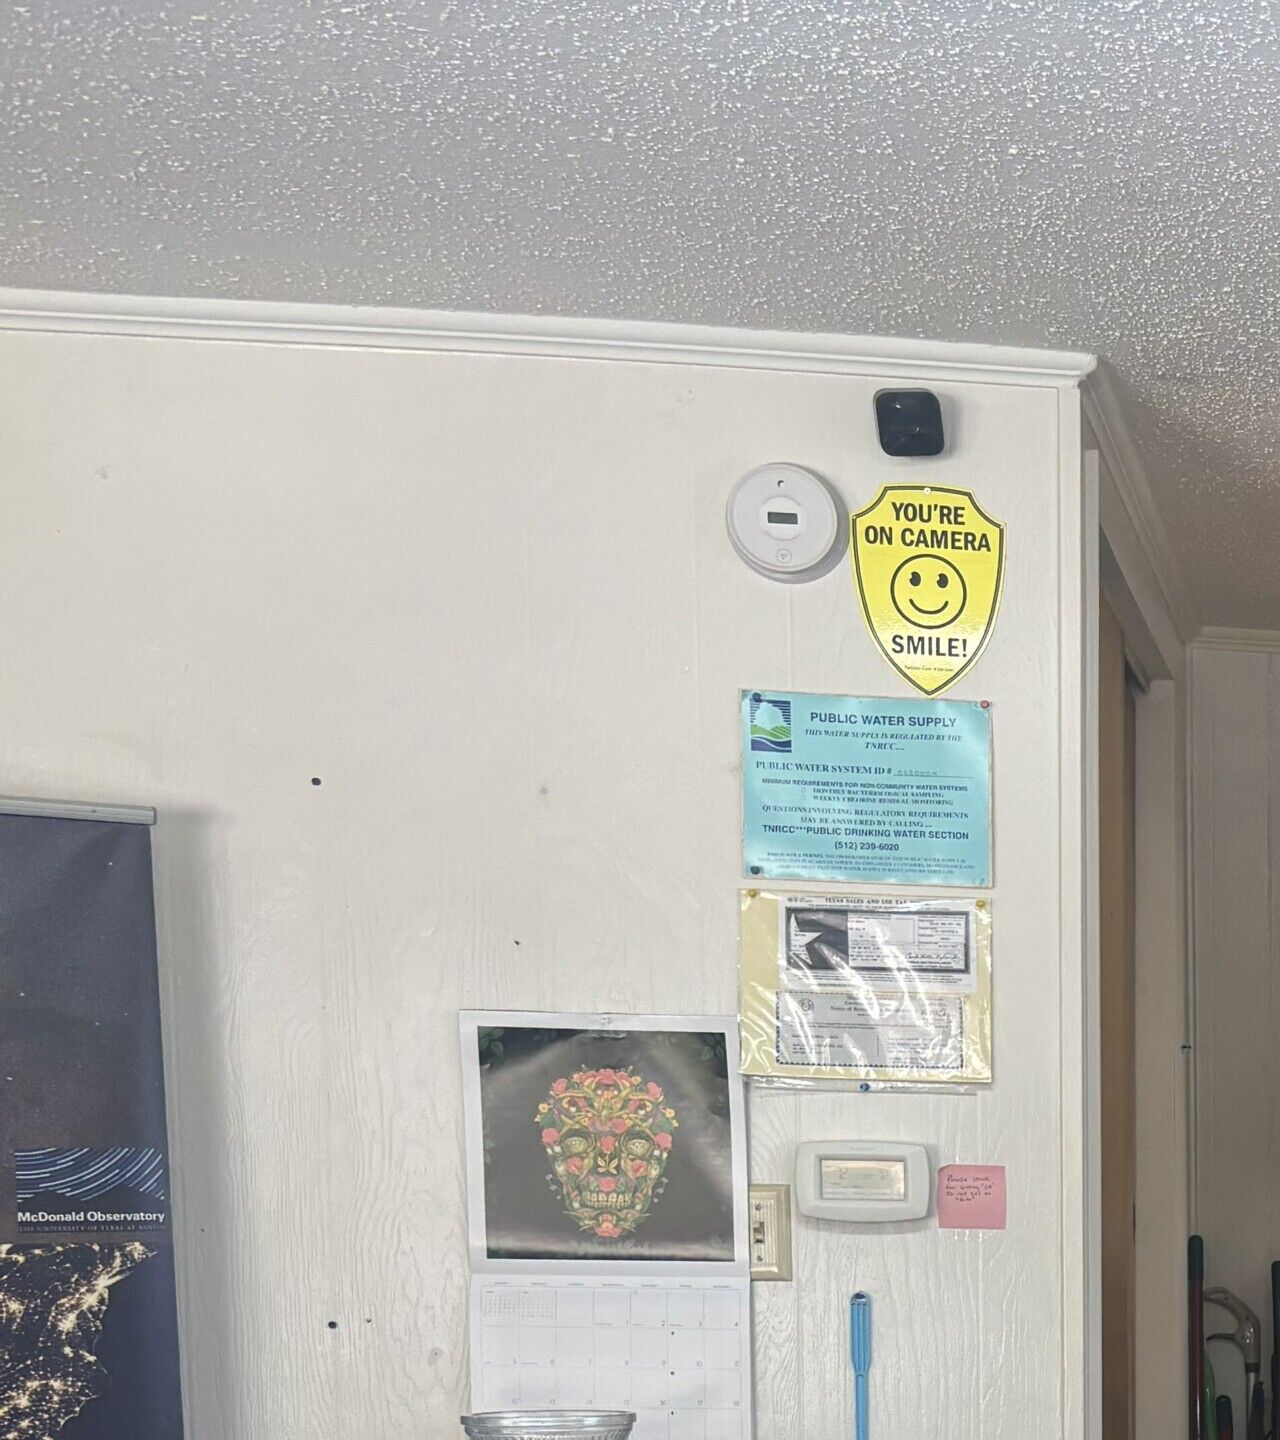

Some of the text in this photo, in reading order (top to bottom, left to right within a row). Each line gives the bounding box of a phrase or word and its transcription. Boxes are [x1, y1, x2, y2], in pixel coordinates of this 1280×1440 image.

[891, 502, 965, 525] YOU'RE
[865, 525, 991, 552] ON CAMERA
[891, 635, 968, 657] SMILE!
[811, 712, 956, 728] PUBLIC WATER SUPPLY
[844, 828, 969, 840] DRINKING WATER SECTION
[835, 841, 899, 852] (512) 239-6020
[18, 1212, 164, 1223] McDonald Observatory
